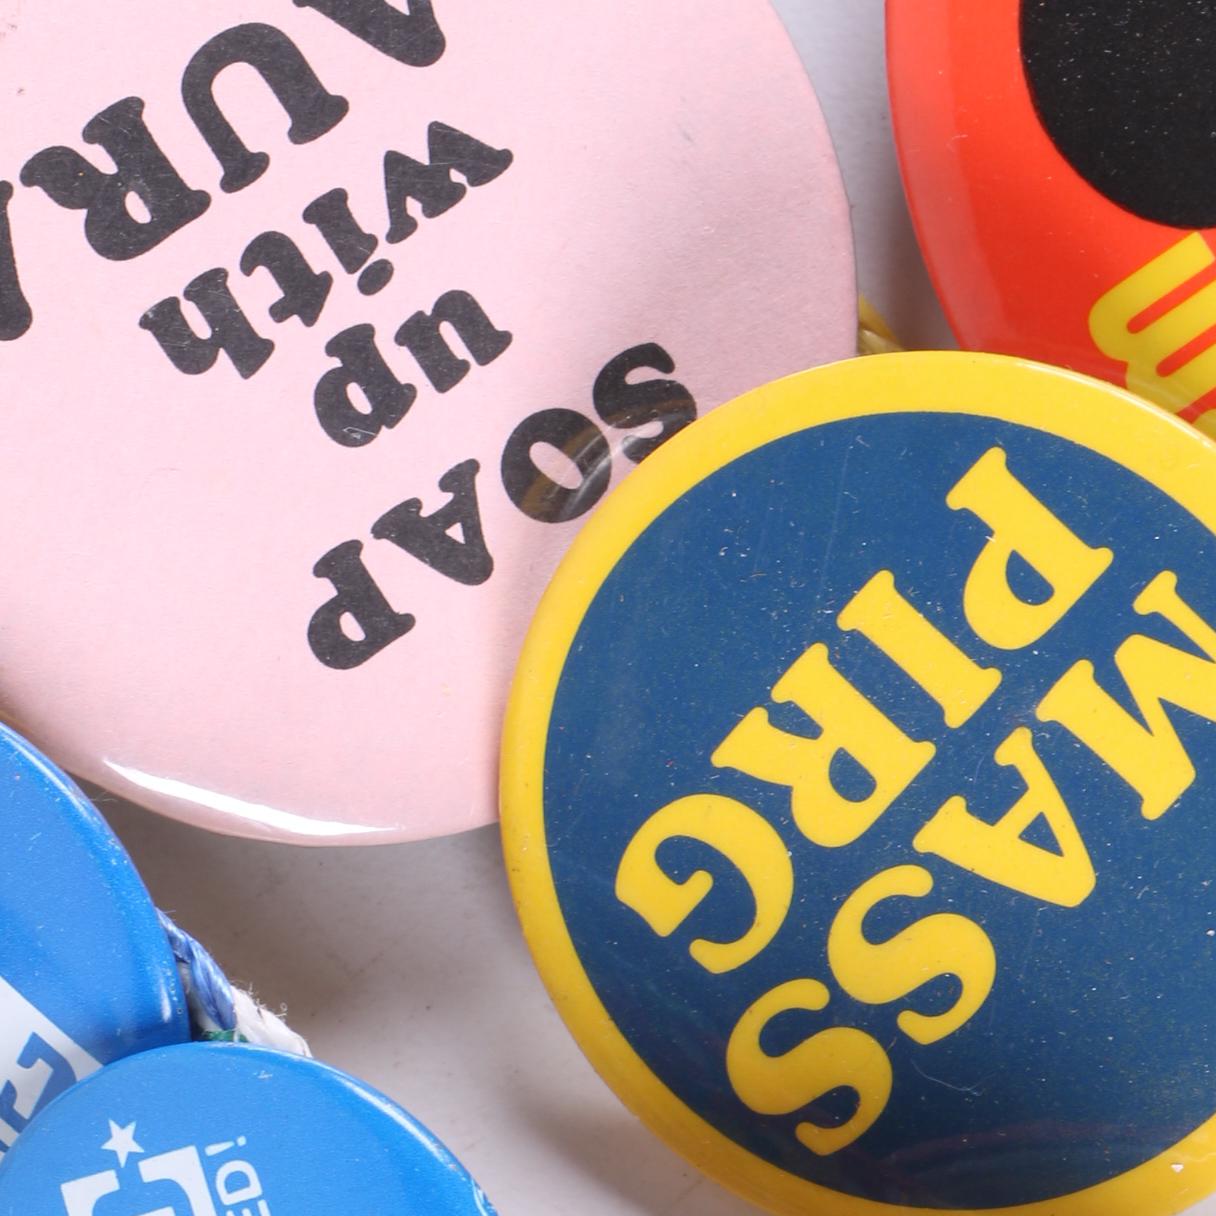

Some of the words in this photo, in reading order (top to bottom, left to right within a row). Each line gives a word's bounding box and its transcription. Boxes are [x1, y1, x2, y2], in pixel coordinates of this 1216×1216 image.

[139, 121, 513, 380] with
[313, 289, 513, 447] up
[307, 342, 698, 670] SOAP
[614, 446, 1114, 974] PIRG
